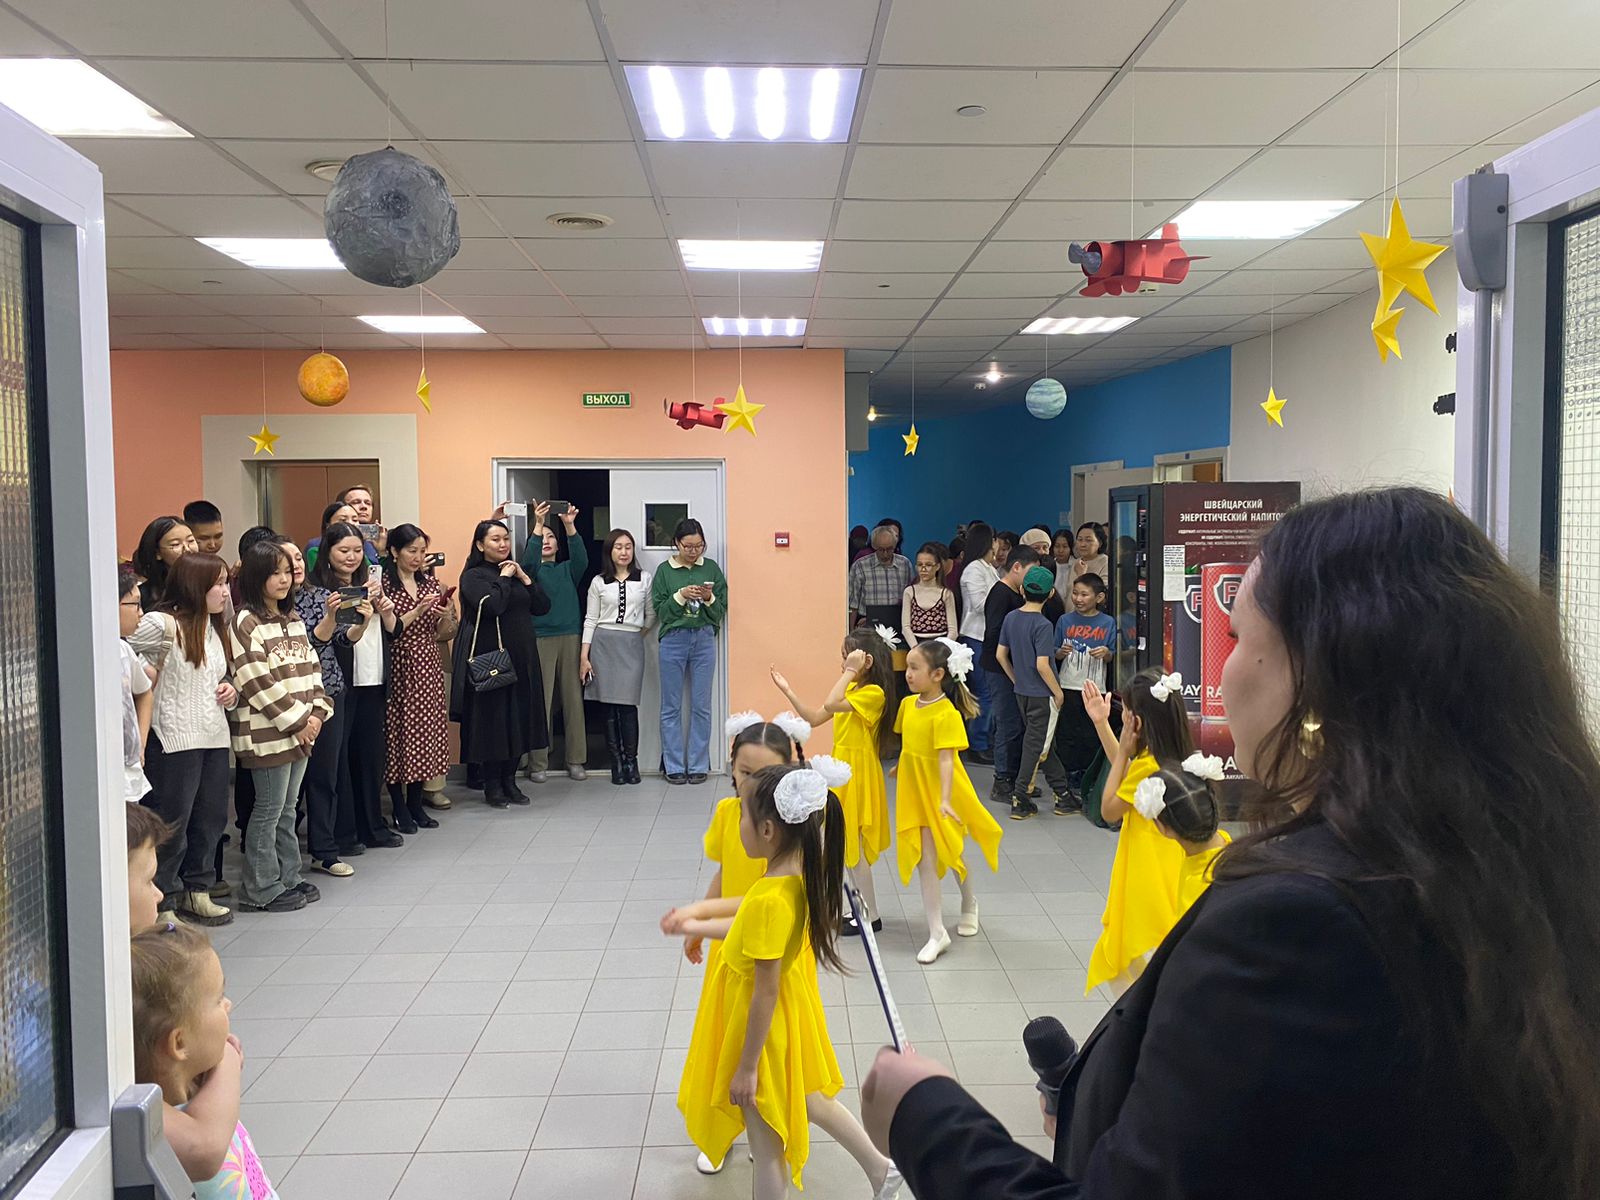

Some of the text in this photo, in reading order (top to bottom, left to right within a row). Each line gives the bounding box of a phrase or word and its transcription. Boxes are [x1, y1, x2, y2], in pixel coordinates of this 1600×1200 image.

[586, 394, 626, 405] ВЫХОД
[1204, 499, 1263, 510] ШВЕЙЦАРСКИЙ
[1180, 512, 1248, 522] ЭНЕРГЕТИЧЕСКИЙ
[1066, 624, 1107, 640] URBAN
[1206, 686, 1222, 698] RA
